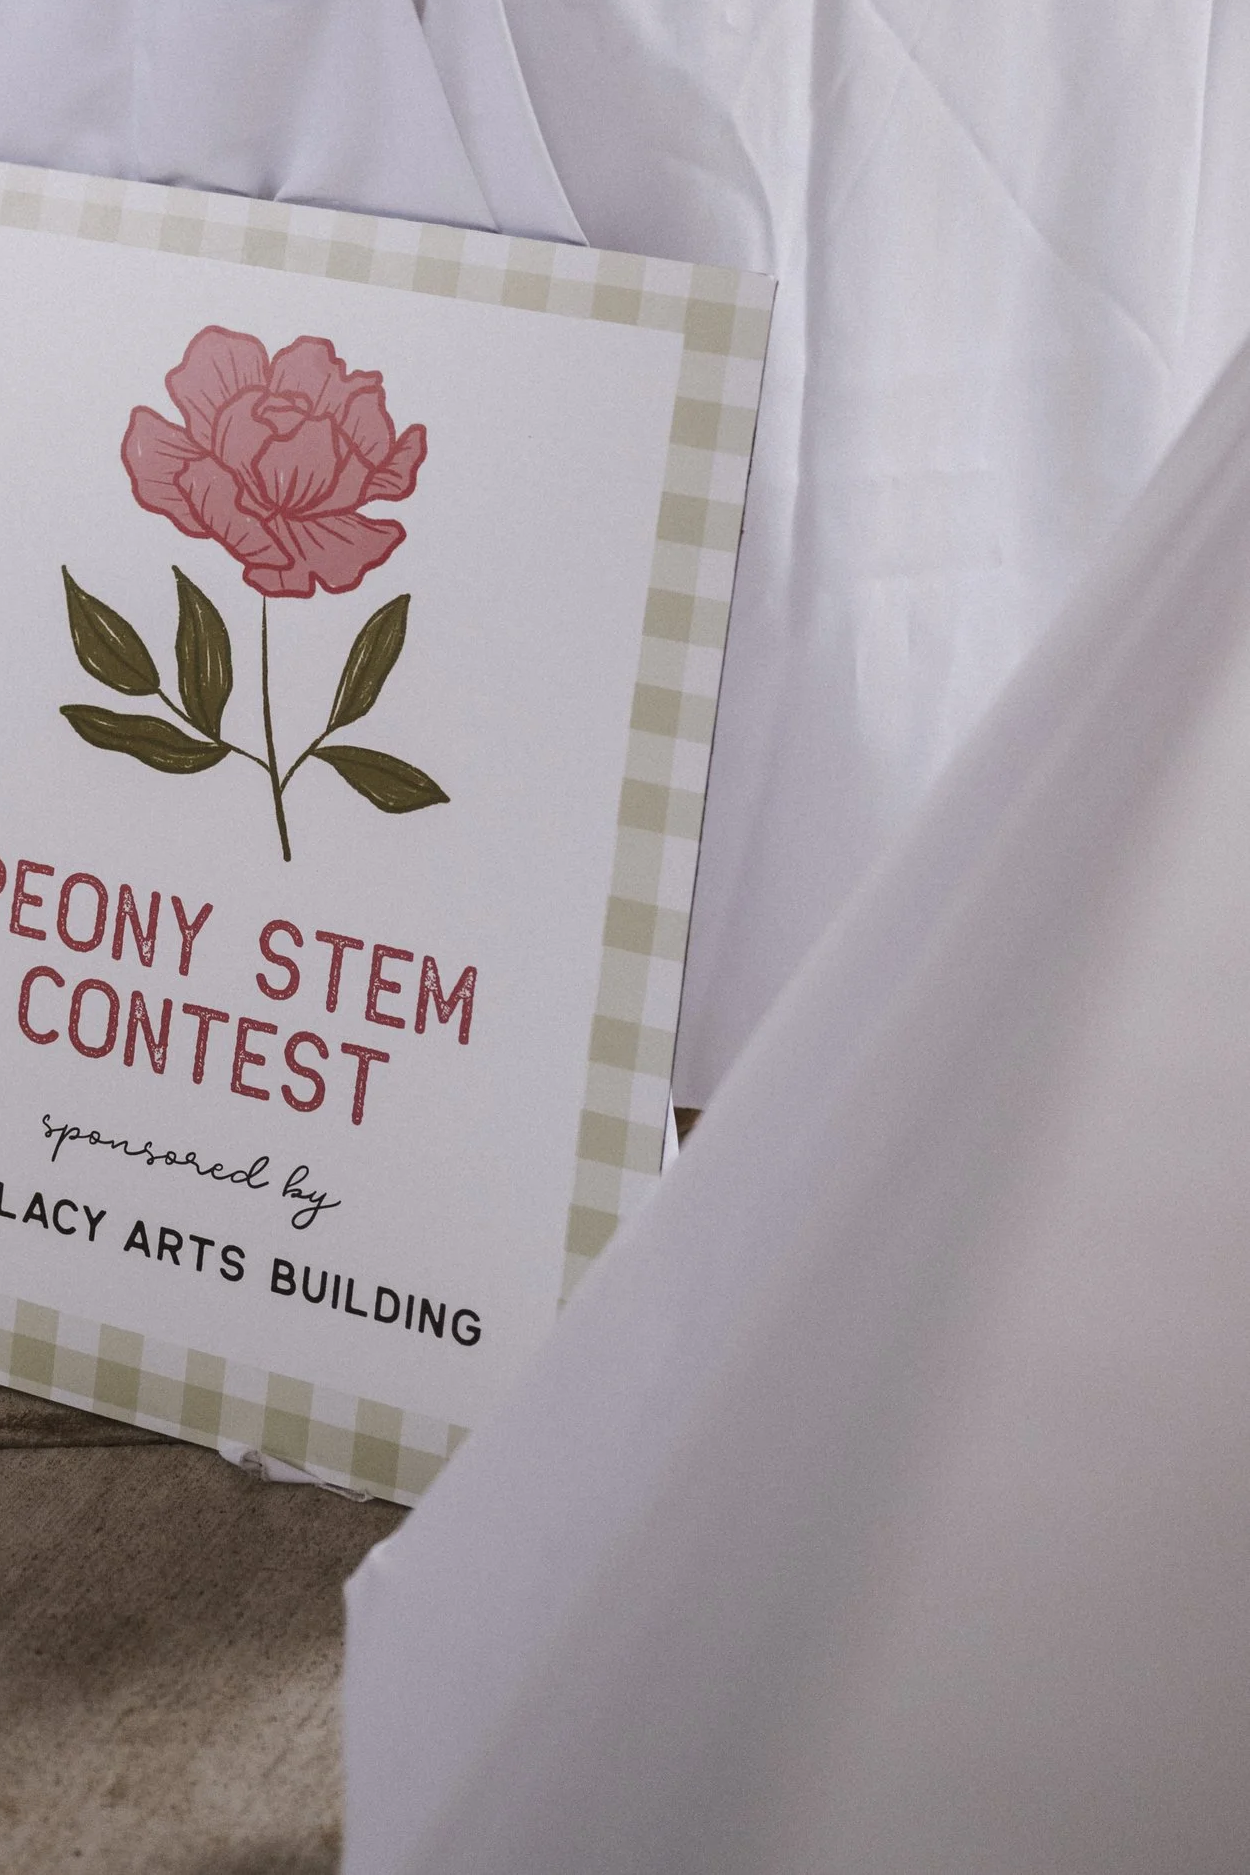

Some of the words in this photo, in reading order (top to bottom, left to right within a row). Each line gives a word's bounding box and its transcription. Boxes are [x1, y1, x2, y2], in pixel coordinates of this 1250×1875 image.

[18, 966, 391, 1126] CONTEST
[256, 920, 478, 1046] STEM
[42, 1113, 270, 1190] sponsored
[281, 1165, 342, 1231] by
[124, 1219, 246, 1283] ARTS
[270, 1258, 482, 1347] BUILDING
